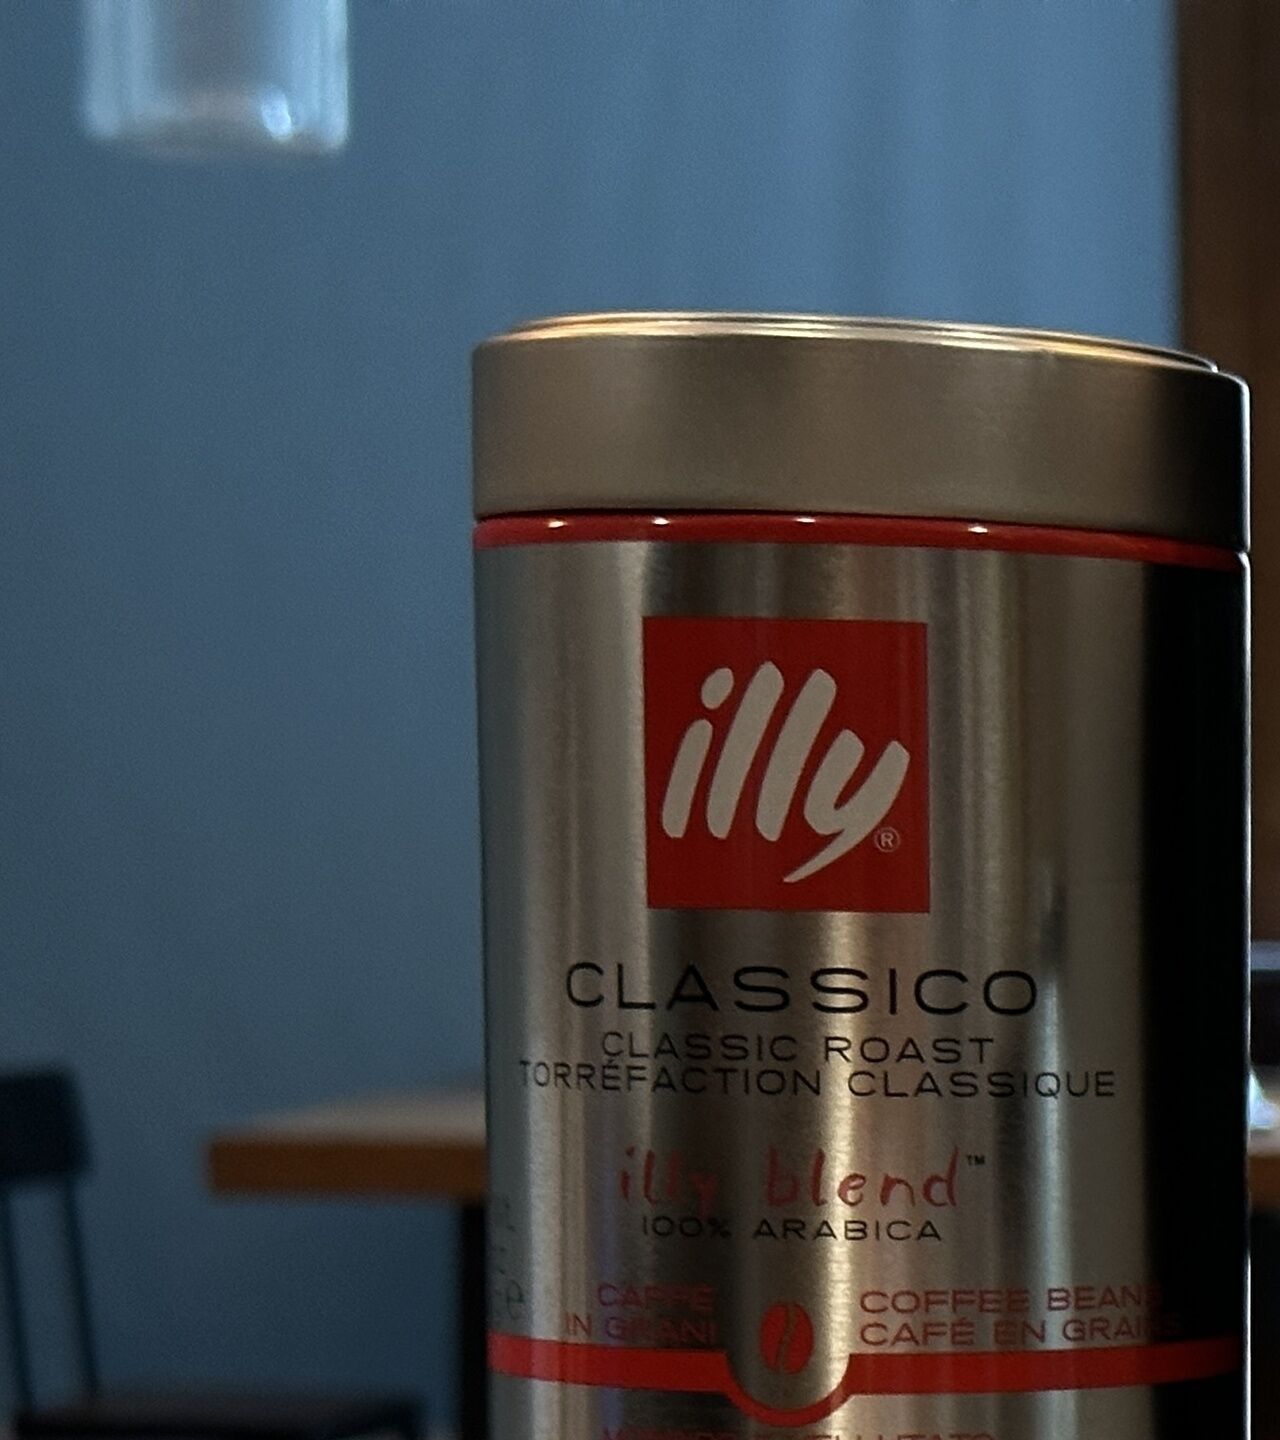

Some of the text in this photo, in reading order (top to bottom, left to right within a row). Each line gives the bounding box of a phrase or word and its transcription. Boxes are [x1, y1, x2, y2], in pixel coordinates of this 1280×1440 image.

[661, 660, 912, 884] illy
[565, 961, 1038, 1016] CLASSICO
[602, 1030, 995, 1065] CLASSIC ROAST
[519, 1058, 1116, 1100] TORRÉFACTION CLASSIQUE
[766, 1145, 959, 1208] blend
[642, 1215, 942, 1242] 100% ARABICA
[859, 1287, 1031, 1315] COFFEE
[859, 1313, 1182, 1347] CAFÉ EN GRAI
